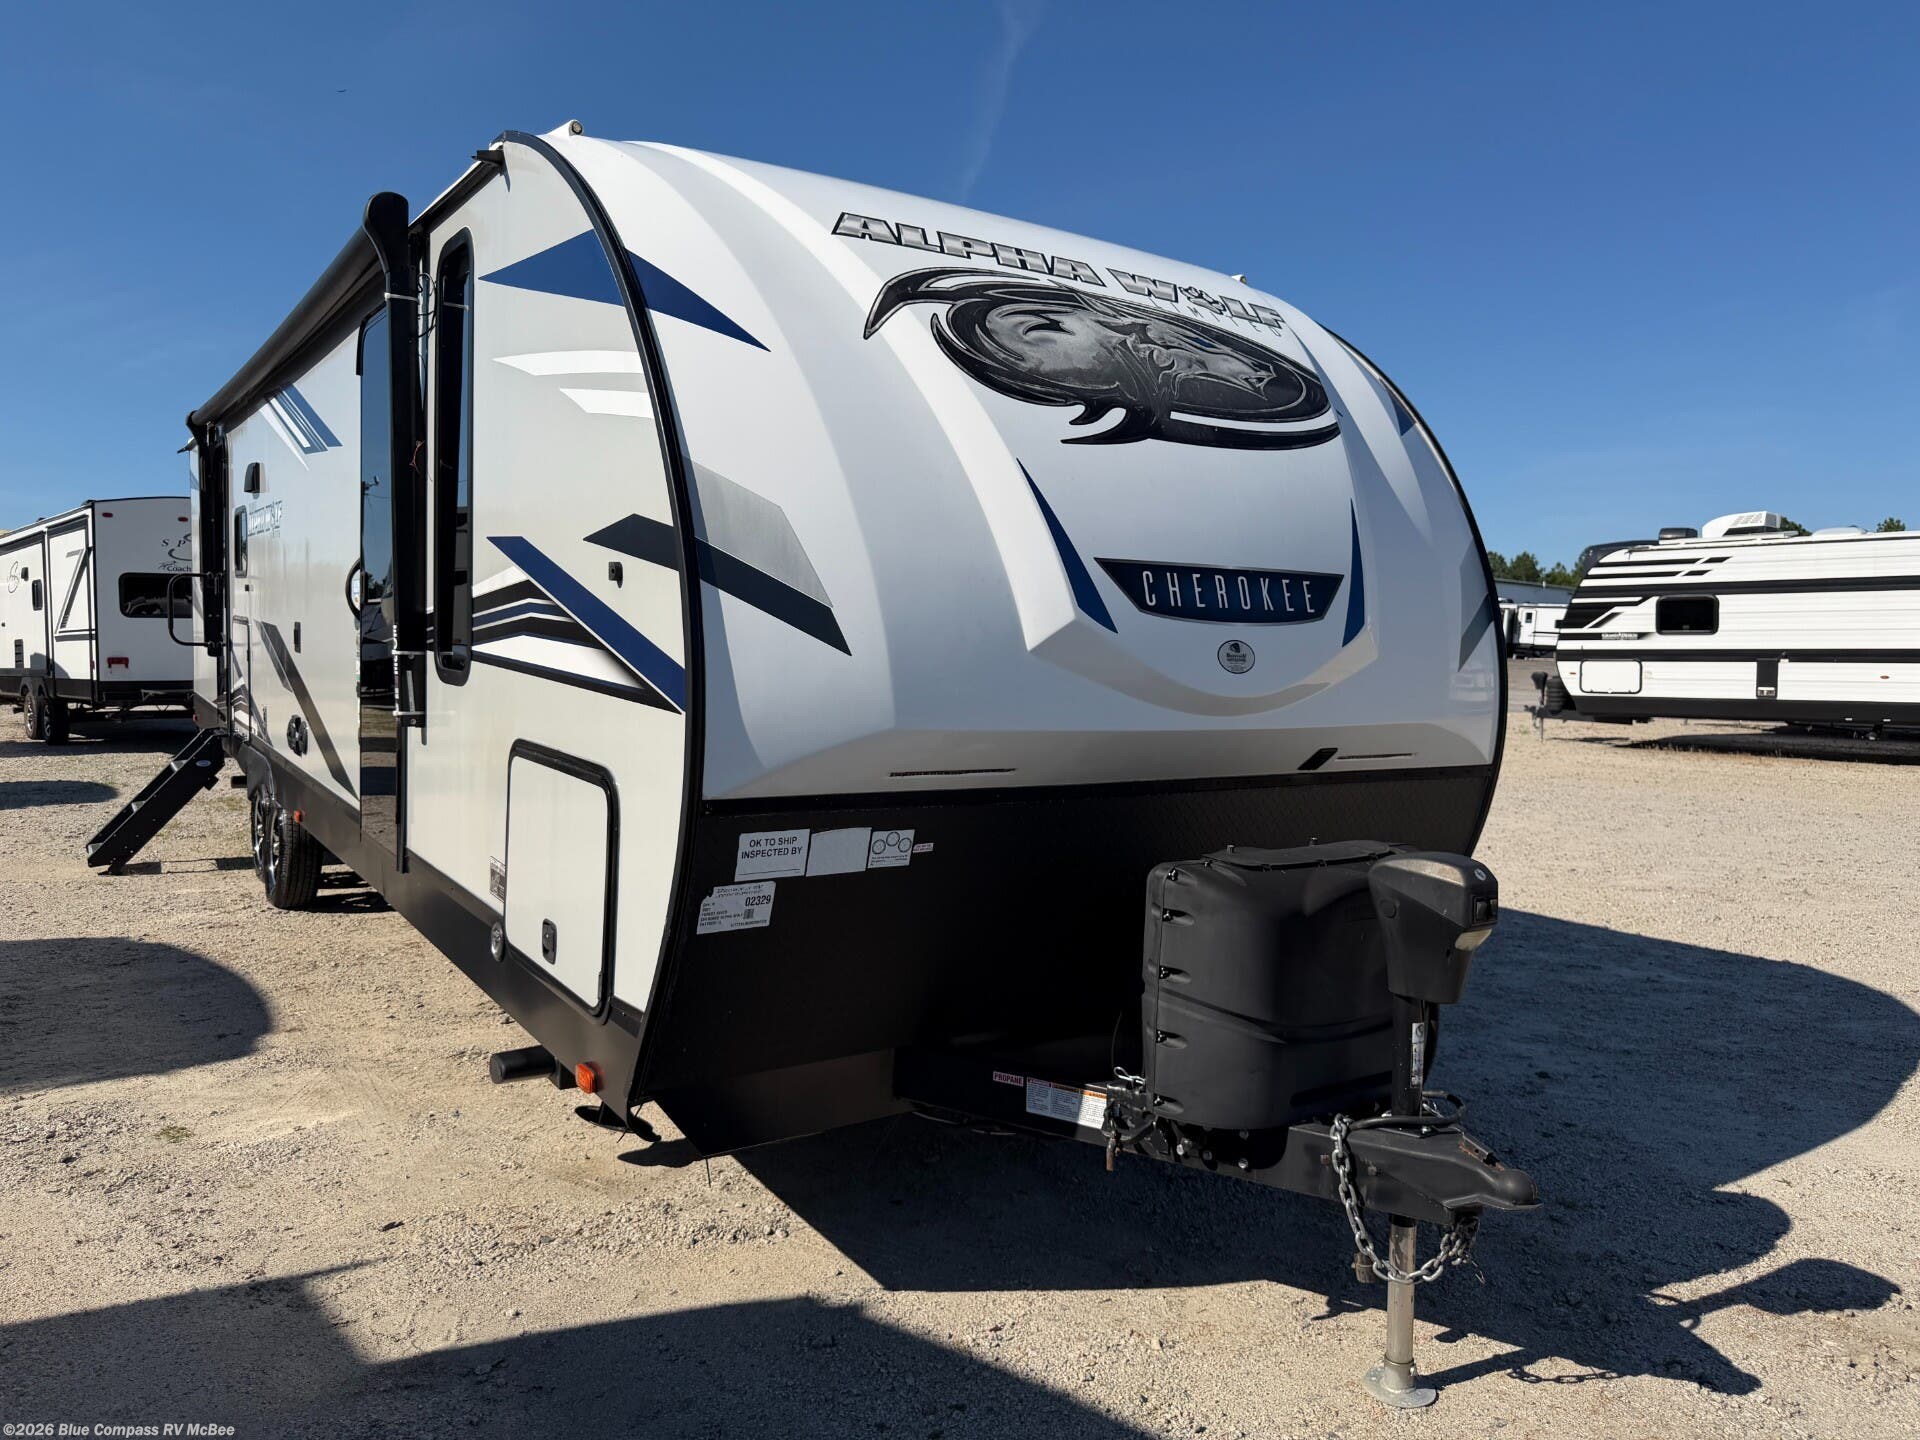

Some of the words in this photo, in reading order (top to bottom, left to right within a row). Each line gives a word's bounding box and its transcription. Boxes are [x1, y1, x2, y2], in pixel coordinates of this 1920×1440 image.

[832, 211, 1106, 287] ALPHA
[1142, 570, 1316, 613] CHEROKEE
[749, 839, 762, 848] OK
[765, 838, 776, 847] TO
[778, 836, 798, 846] SHIP
[741, 847, 789, 859] INSPECTED
[790, 846, 803, 855] BY
[745, 894, 772, 907] 02329
[994, 1072, 1024, 1086] PROPANE
